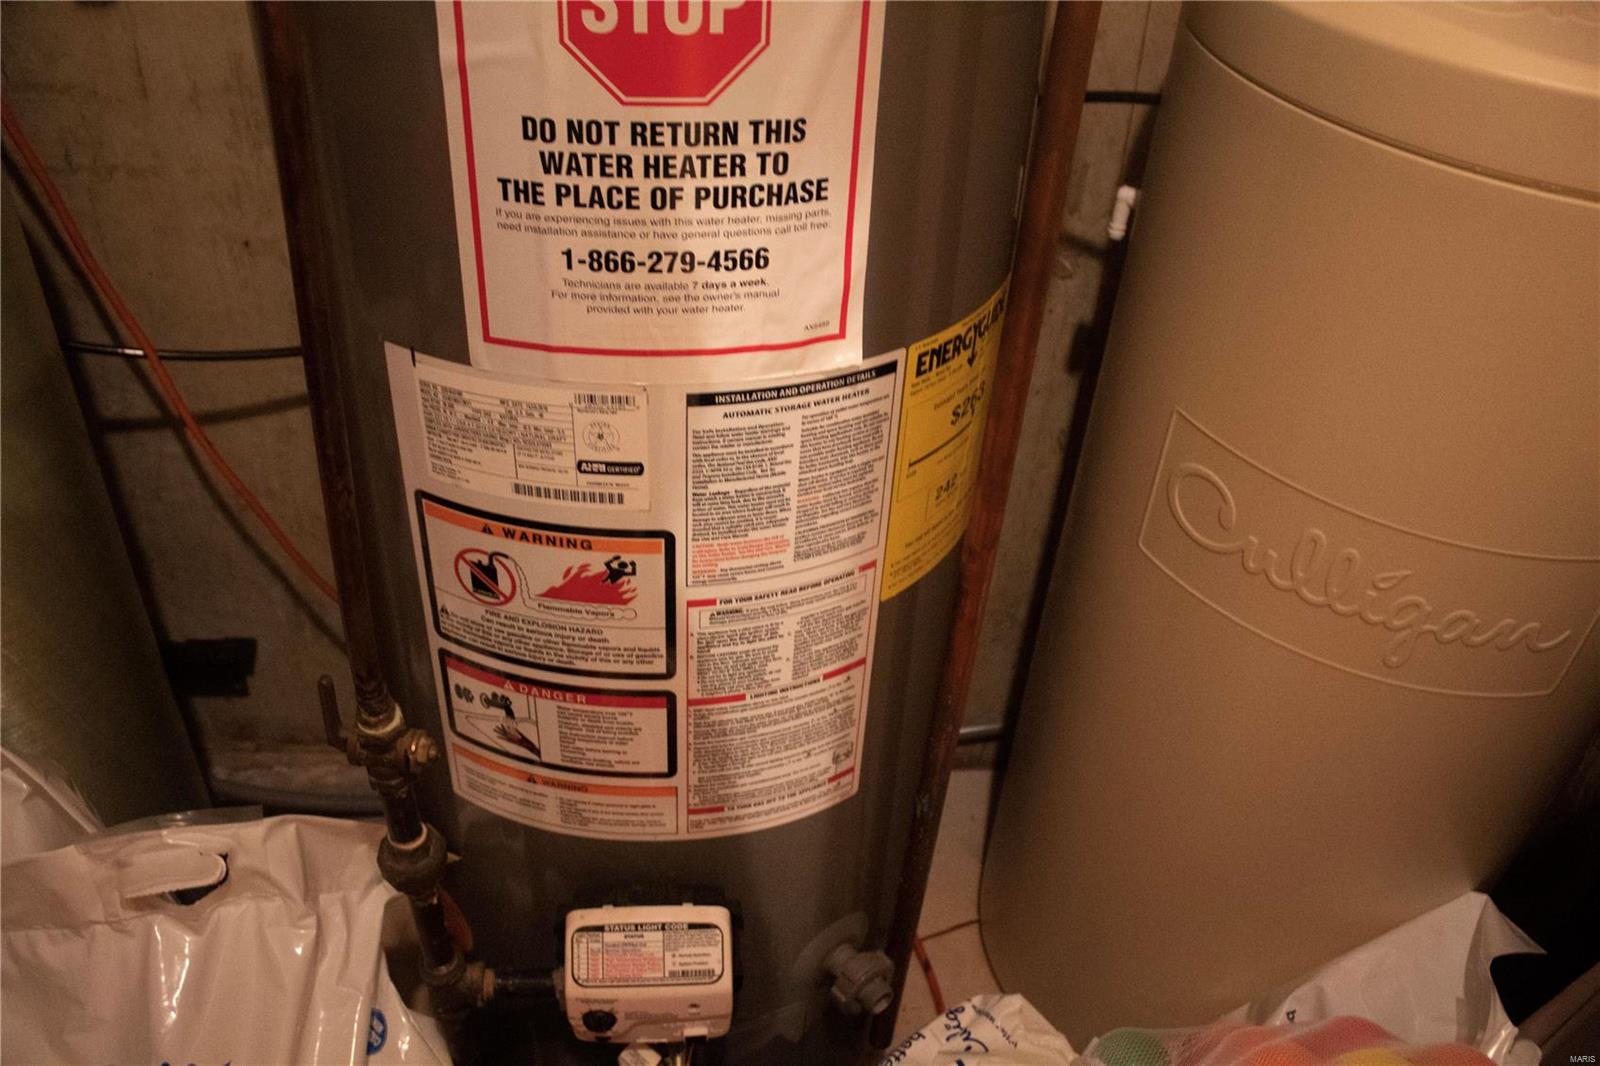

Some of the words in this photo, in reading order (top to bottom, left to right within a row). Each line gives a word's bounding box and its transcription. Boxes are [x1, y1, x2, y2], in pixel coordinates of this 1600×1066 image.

[521, 115, 556, 144] DO
[566, 118, 620, 146] NOT
[630, 121, 739, 148] RETURN
[748, 117, 808, 144] THIS
[538, 150, 633, 178] WATER
[643, 152, 747, 179] HEATER
[756, 151, 790, 176] TO
[496, 177, 546, 206] THE
[555, 182, 640, 210] PLACE
[650, 186, 684, 210] OF
[694, 177, 830, 210] PURCHASE
[495, 207, 502, 217] If
[504, 209, 523, 220] you
[526, 213, 541, 222] are
[544, 214, 610, 227] experiencing
[613, 217, 646, 226] issues
[650, 217, 671, 226] with
[674, 217, 692, 226] this
[696, 216, 724, 226] water
[765, 210, 802, 223] missing
[496, 222, 522, 232] need
[524, 224, 578, 237] installation
[580, 230, 636, 238] assistance
[653, 230, 678, 239] have
[681, 228, 720, 240] general
[724, 226, 772, 240] questions
[775, 224, 792, 234] call
[793, 222, 808, 232] toll
[561, 247, 770, 274] 1-866-279-4566
[551, 290, 568, 300] For
[570, 292, 597, 300] more
[662, 294, 681, 302] see
[684, 292, 700, 302] the
[744, 288, 780, 299] manual
[562, 278, 622, 290] Technicians
[624, 282, 641, 290] are
[644, 280, 688, 291] available
[692, 281, 698, 290] 7
[702, 279, 727, 291] days
[586, 304, 630, 315] provided
[633, 305, 654, 315] with
[657, 307, 678, 316] your
[682, 305, 709, 314] water
[714, 389, 778, 404] INSTALLATION
[779, 386, 798, 398] AND
[800, 377, 845, 394] OPERATION
[846, 369, 877, 386] DETAILS
[722, 406, 772, 419] AUTOMATIC
[774, 402, 811, 414] STORAGE
[814, 395, 840, 408] WATER
[842, 388, 870, 401] HEATER
[502, 527, 592, 550] WARNING
[1167, 463, 1571, 668] Culligan
[537, 603, 582, 615] Flammable
[585, 608, 615, 618] Vapors
[484, 608, 501, 618] FIRE
[504, 614, 520, 622] AND
[522, 618, 567, 632] EXPLOSION
[568, 625, 604, 635] HAZARD
[518, 684, 587, 704] DANGER
[542, 780, 588, 793] WARNING
[604, 923, 635, 932] STATUS
[637, 923, 662, 932] LIGHT
[664, 922, 688, 932] CODE
